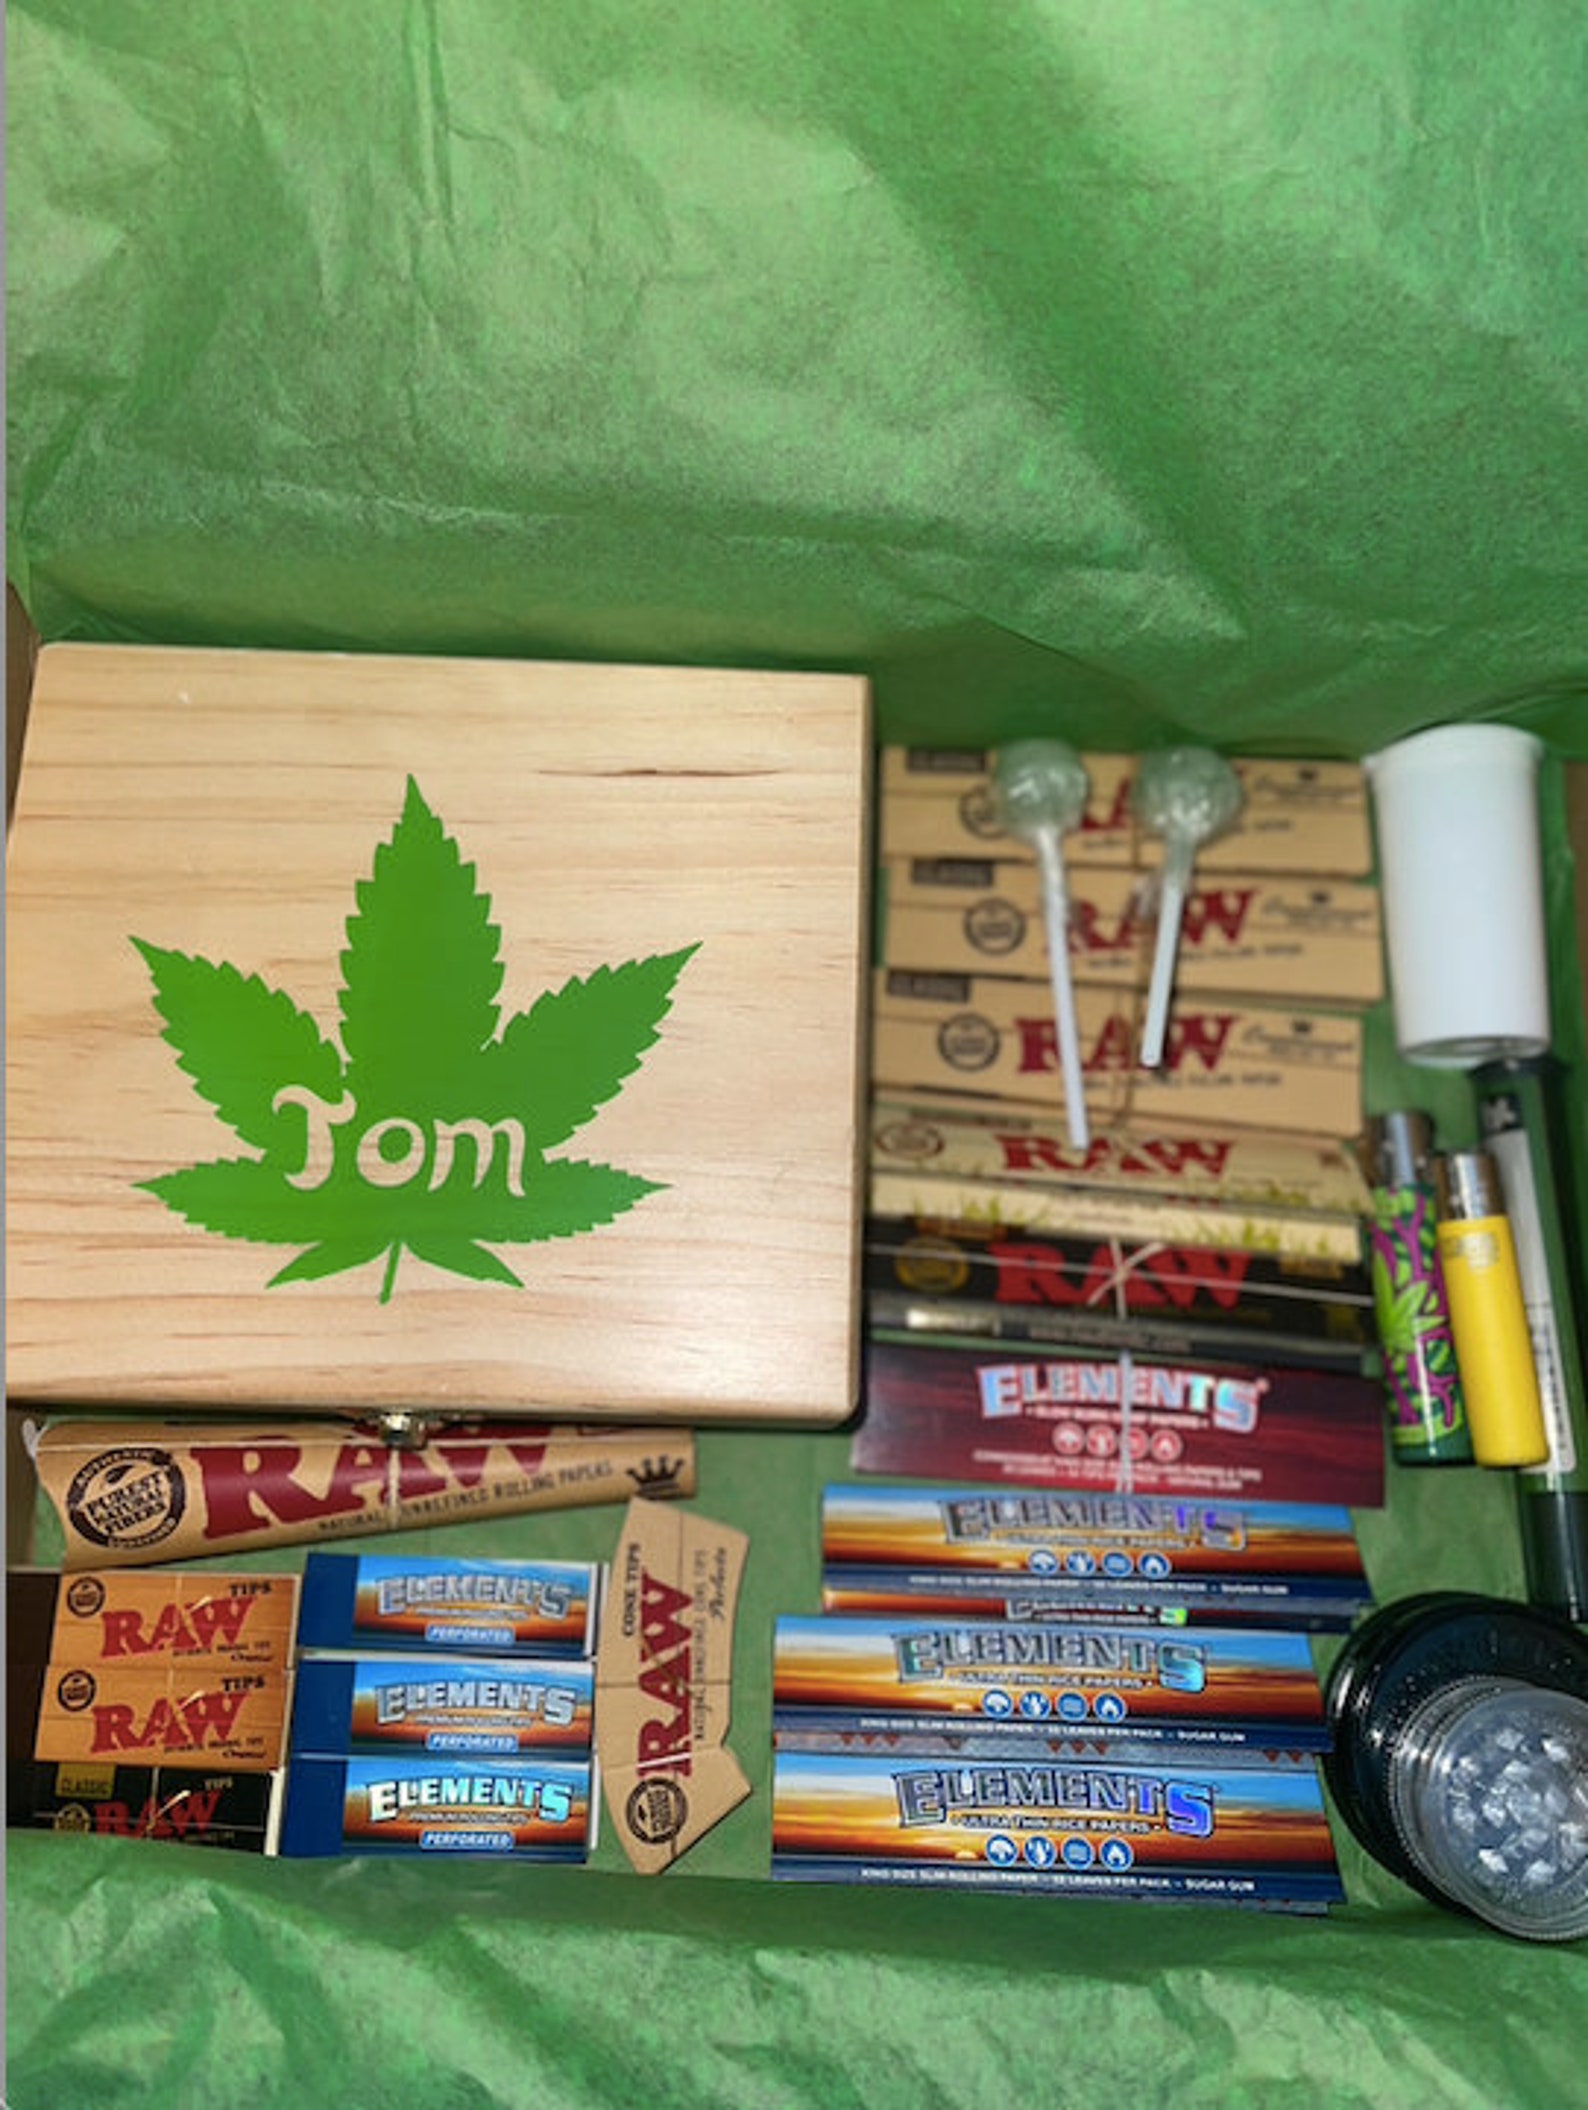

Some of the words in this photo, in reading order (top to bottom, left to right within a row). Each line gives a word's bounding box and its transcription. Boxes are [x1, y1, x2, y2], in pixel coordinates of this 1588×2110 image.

[1014, 1013, 1236, 1074] RAW
[272, 1084, 525, 1197] Tom
[995, 1135, 1236, 1177] RAW
[989, 1242, 1254, 1312] RAW
[976, 1363, 1259, 1432] ELEMENTS
[190, 1421, 553, 1539] RAW
[940, 1498, 1247, 1551] ELEMENTS
[229, 1581, 272, 1596] TIPS
[376, 1574, 572, 1620] ELEMENTS
[101, 1597, 256, 1658] RAW
[430, 1626, 512, 1642] PERFORATED
[222, 1676, 265, 1692] TIPS
[637, 1565, 694, 1777] RAW
[892, 1629, 1207, 1692] ELEMENTS
[91, 1691, 248, 1753] RAW
[375, 1681, 575, 1725] ELEMENTS
[431, 1734, 514, 1750] PERFORATED
[93, 1790, 222, 1838] RAW
[369, 1777, 572, 1822] ELEMENTS
[892, 1765, 1215, 1838] ELEMENTS
[425, 1832, 511, 1847] PERFORATED
